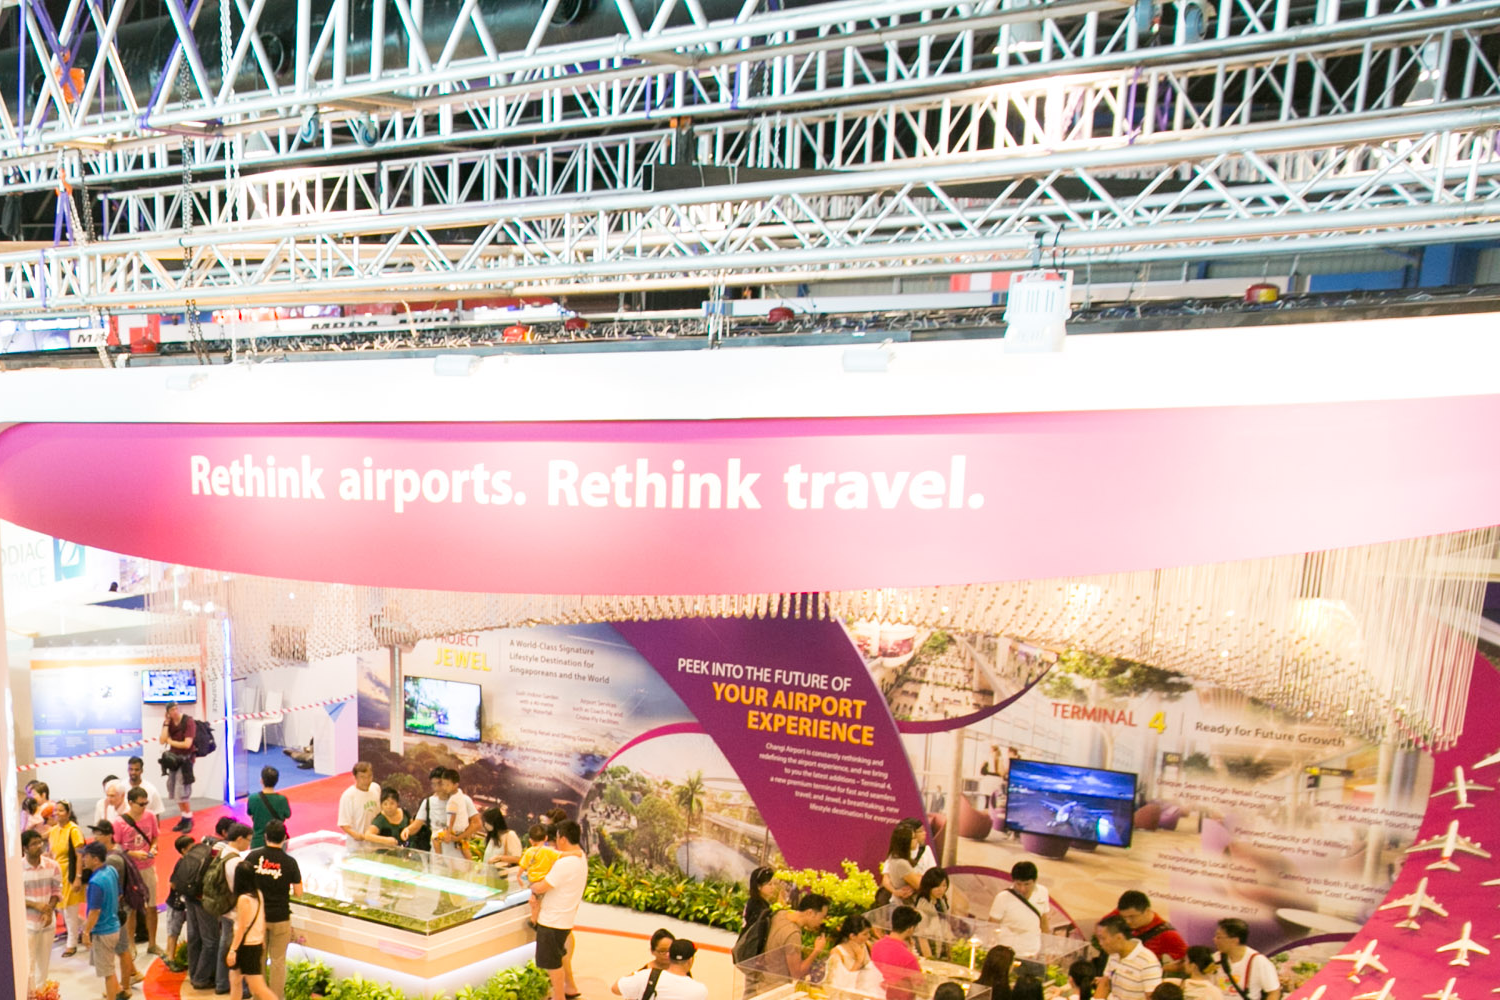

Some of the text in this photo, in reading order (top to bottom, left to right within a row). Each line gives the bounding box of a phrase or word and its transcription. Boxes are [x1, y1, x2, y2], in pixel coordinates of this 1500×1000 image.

[191, 453, 986, 513] Rethink airports. Rethink travel.
[433, 647, 493, 673] JEWEL
[509, 639, 596, 656] A World-Class Signature
[509, 652, 596, 670] Lifestyle Destination for
[509, 664, 611, 685] Singaporeans and the World
[677, 657, 852, 692] PEEK INTO THE FUTURE OF
[711, 681, 868, 721] YOUR AIRPORT
[746, 709, 876, 746] EXPERIENCE
[1051, 702, 1167, 735] TERMINAL 4
[1195, 720, 1346, 748] Ready for Future Growth
[765, 742, 786, 753] Changi
[786, 745, 807, 756] Airport
[812, 749, 841, 761] constantly
[841, 754, 872, 766] rethinking
